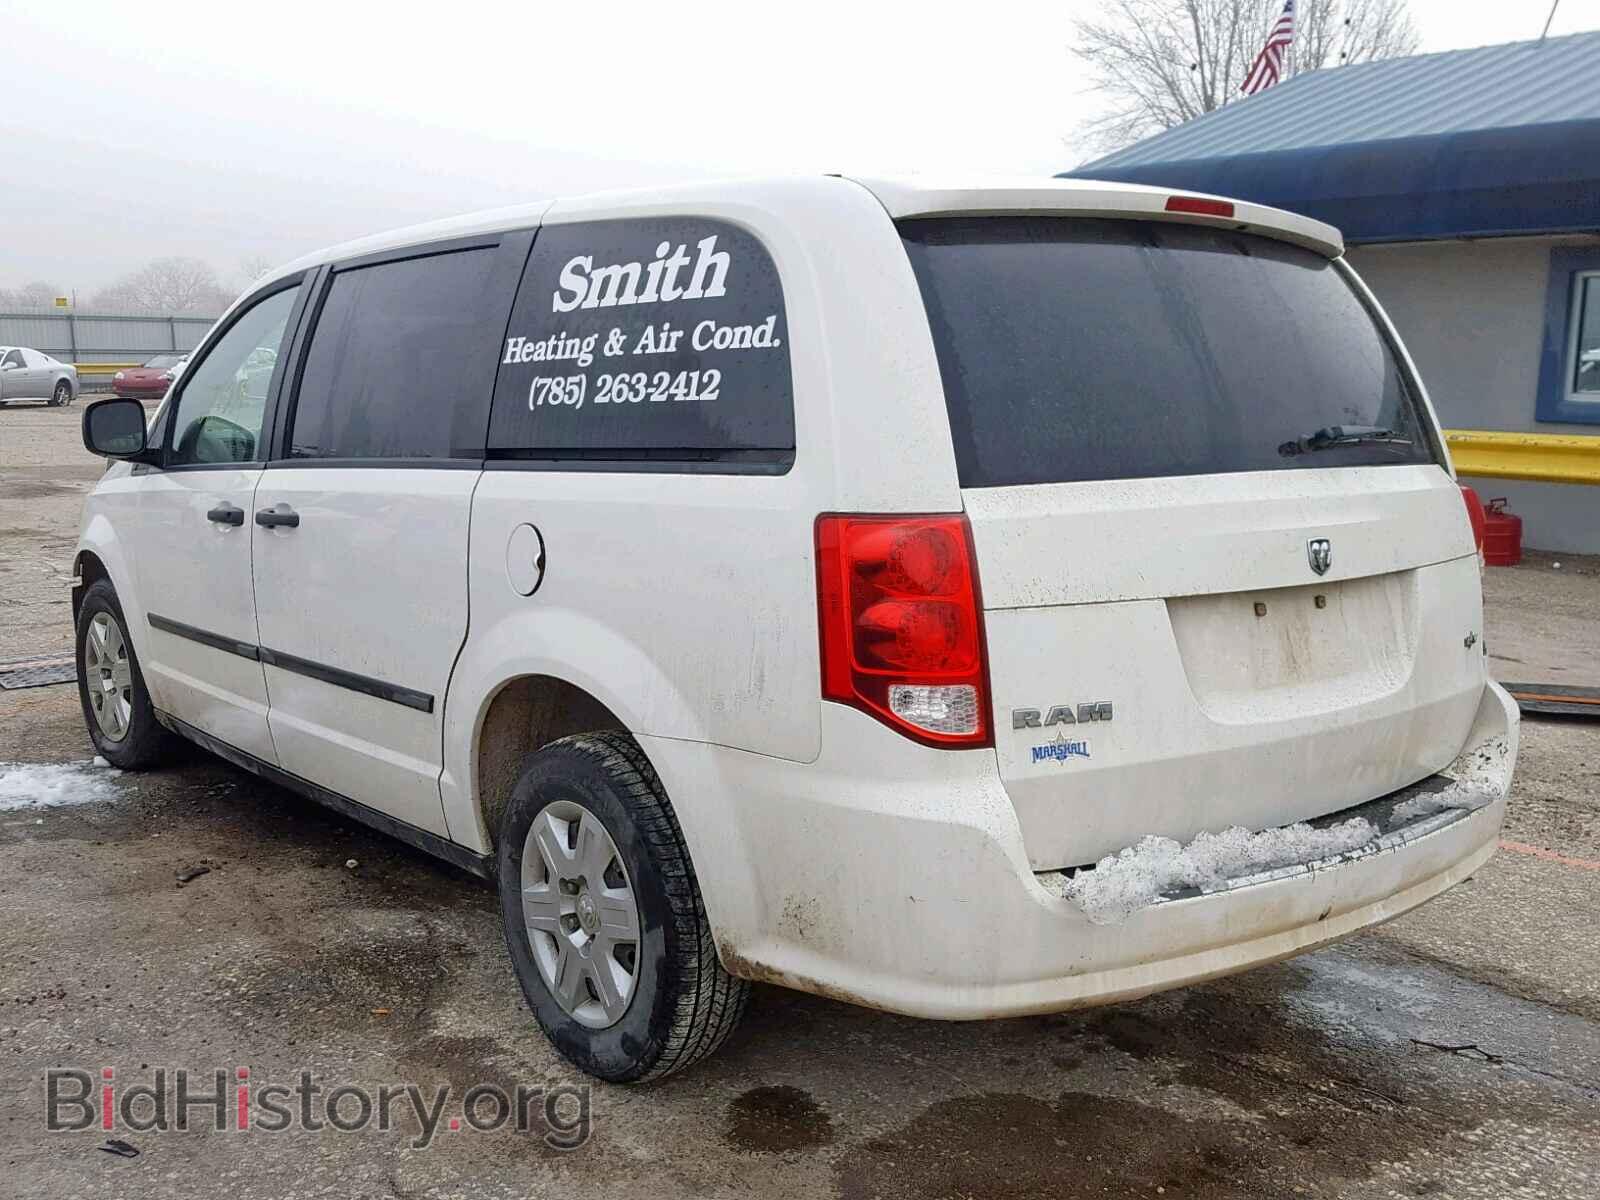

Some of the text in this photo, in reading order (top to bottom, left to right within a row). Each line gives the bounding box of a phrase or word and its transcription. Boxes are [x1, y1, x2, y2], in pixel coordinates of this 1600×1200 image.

[552, 235, 731, 313] Smith
[503, 315, 781, 367] Heating & Air Cond.
[528, 369, 722, 411] (785) 263-2412
[1012, 700, 1113, 730] RAM
[1032, 741, 1090, 764] MARSHALL
